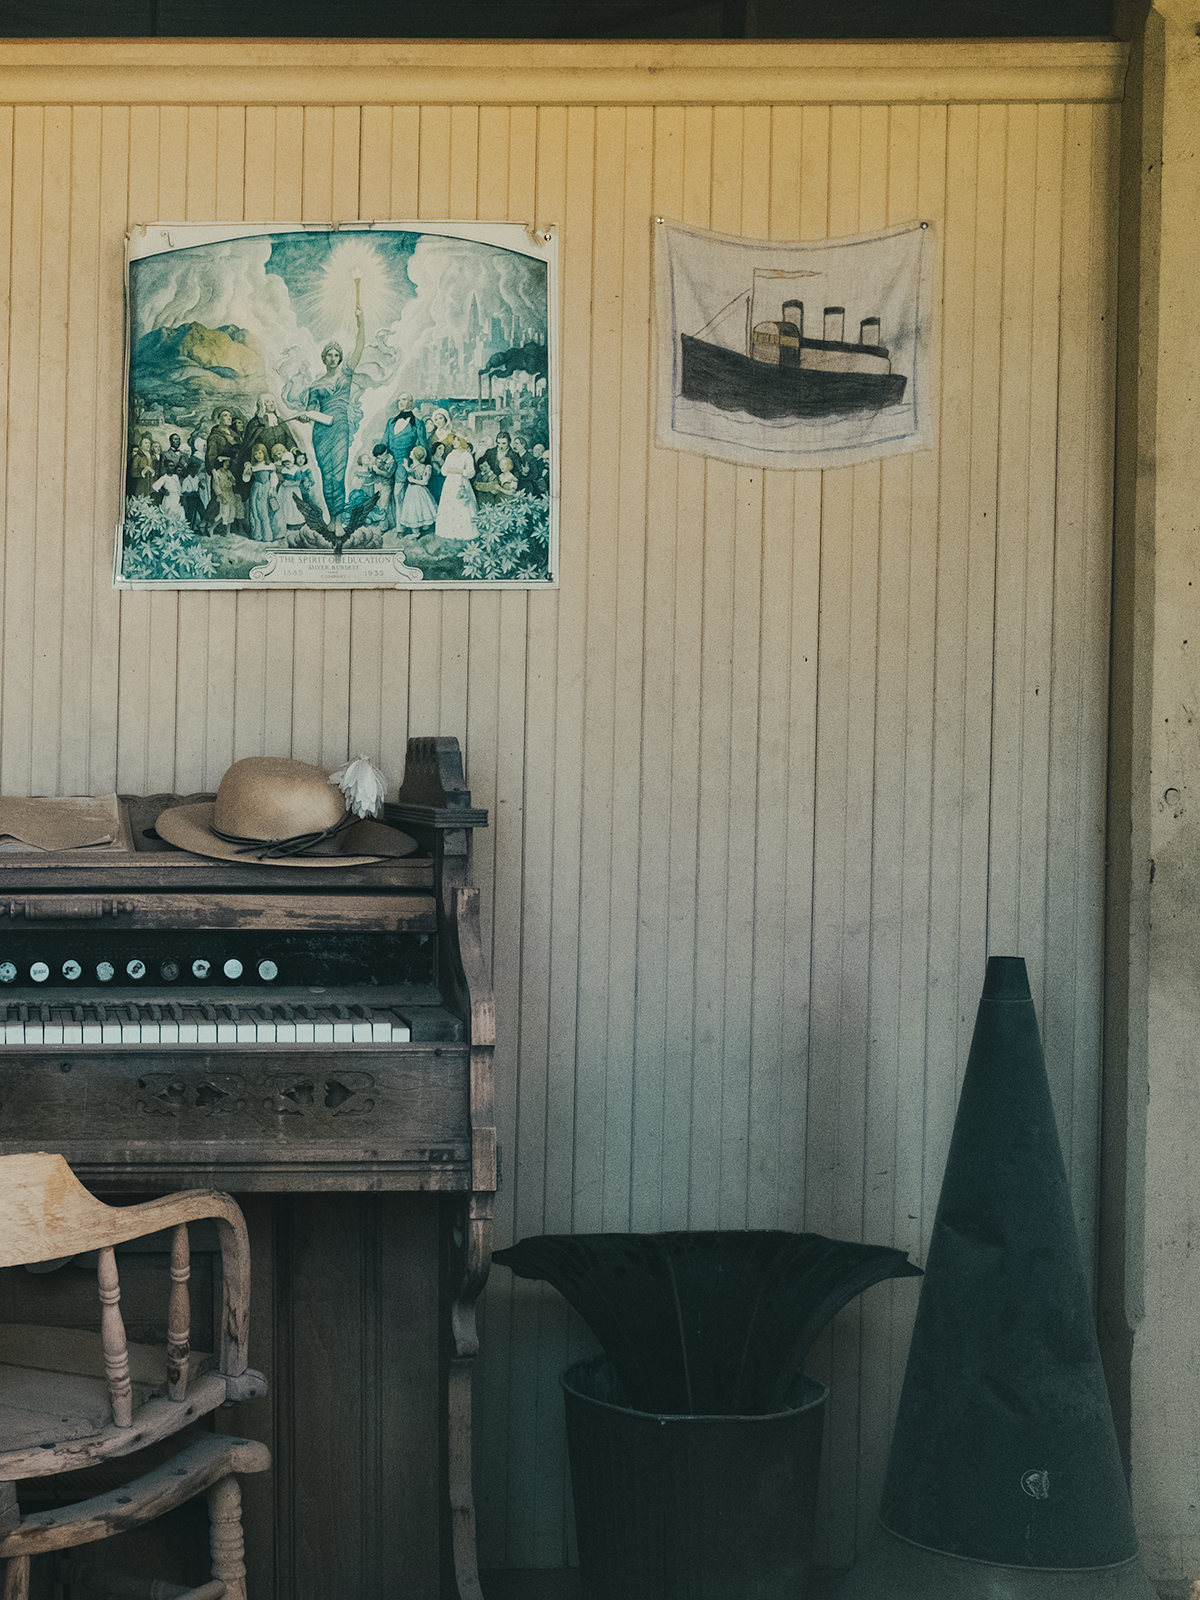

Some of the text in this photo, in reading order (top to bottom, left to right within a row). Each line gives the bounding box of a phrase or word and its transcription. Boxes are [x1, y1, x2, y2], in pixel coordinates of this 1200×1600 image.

[279, 556, 296, 564] THE
[298, 556, 326, 564] SPIRIT
[342, 556, 391, 564] EDUCATION
